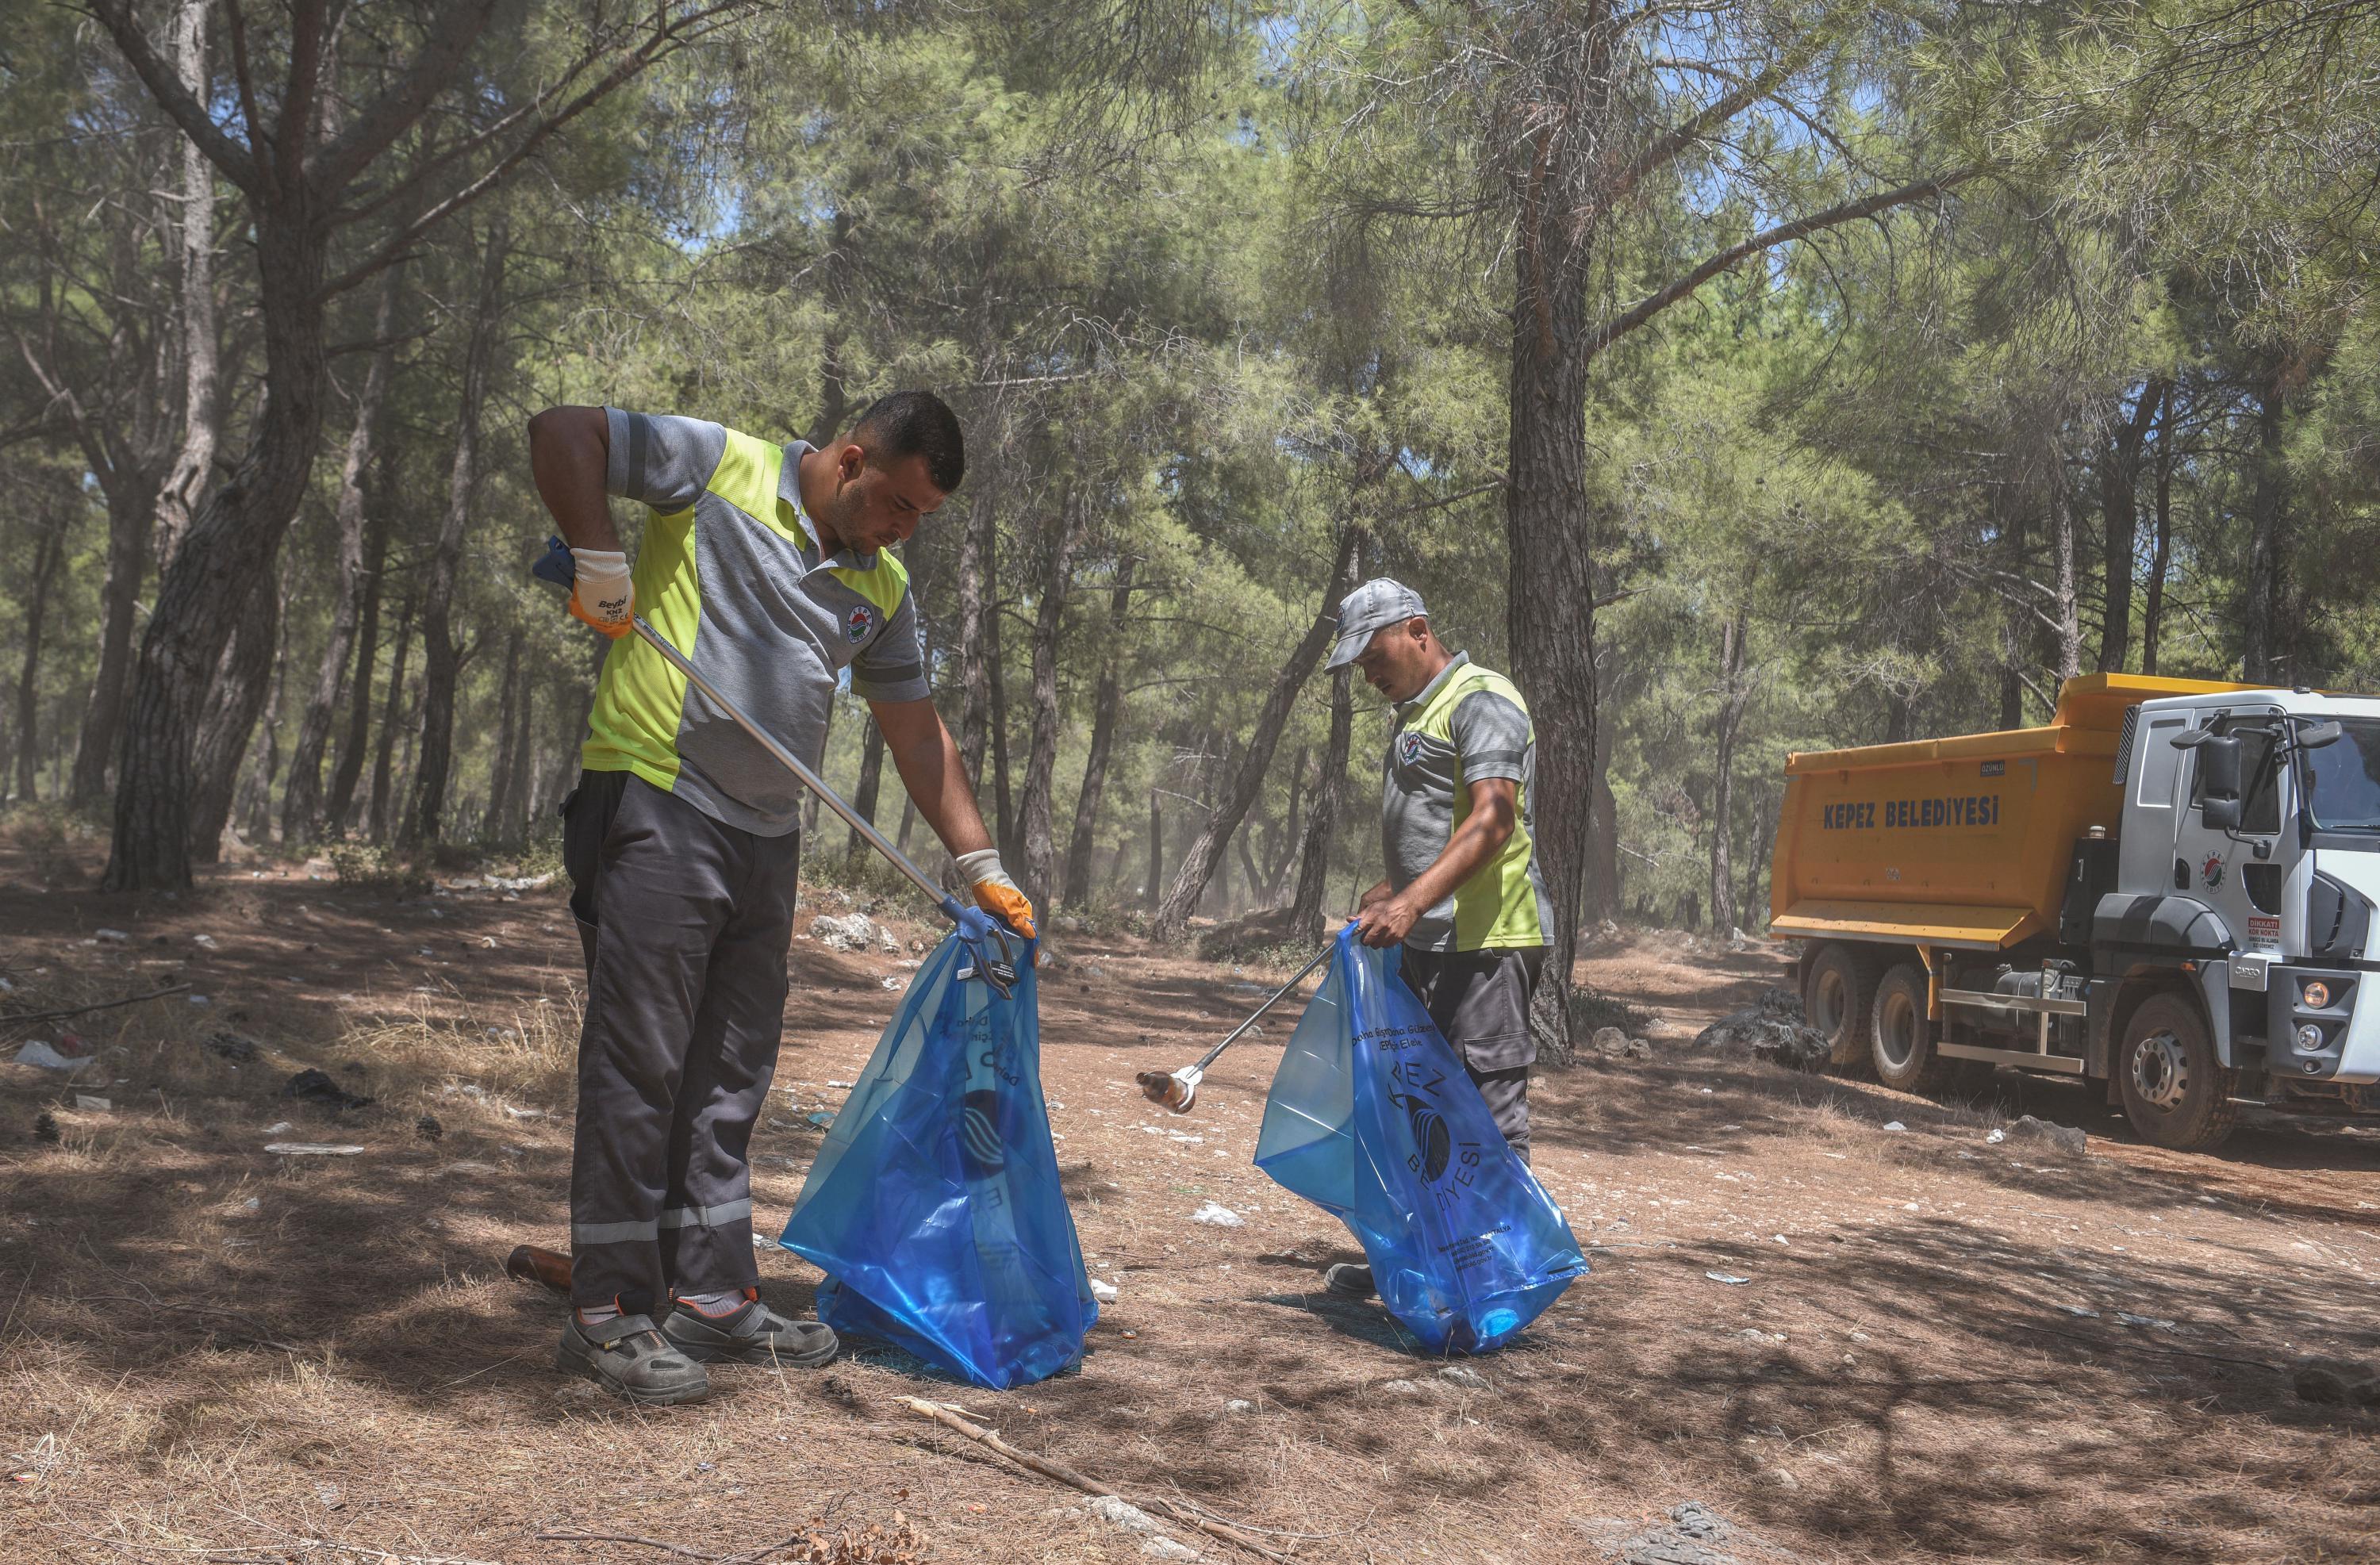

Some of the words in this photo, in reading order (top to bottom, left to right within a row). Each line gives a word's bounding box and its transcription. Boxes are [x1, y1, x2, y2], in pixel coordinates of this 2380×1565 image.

[853, 607, 872, 627] KEPEZ
[1824, 802, 1875, 830] KEPEZ
[1885, 795, 1999, 827] BELEDİYESİ
[2250, 919, 2278, 928] DİKKAT!
[1352, 1030, 1373, 1047] Daha
